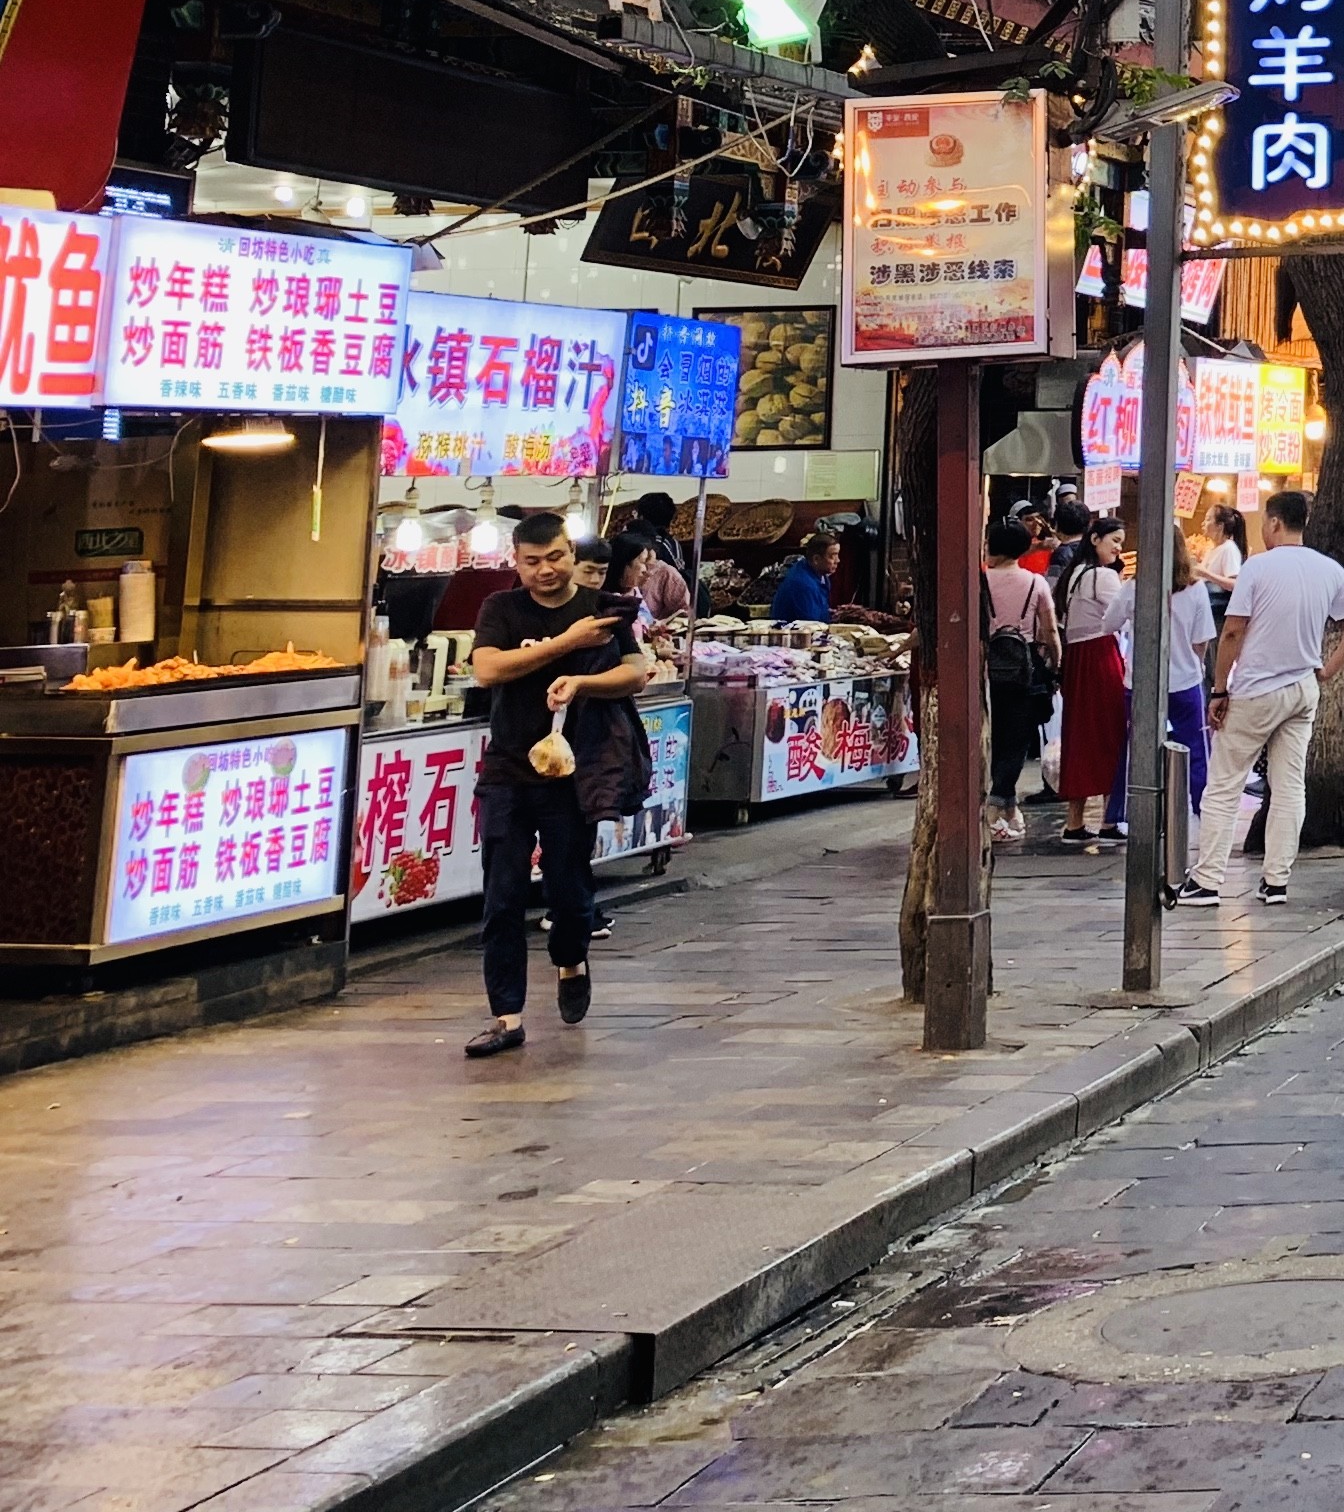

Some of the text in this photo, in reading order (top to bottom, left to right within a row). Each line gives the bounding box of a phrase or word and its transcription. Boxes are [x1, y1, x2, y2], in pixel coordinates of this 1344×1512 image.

[877, 176, 967, 198] 主动参与
[238, 236, 316, 266] 回坊特色小吃
[869, 258, 1017, 285] 涉黑涉恶线索
[126, 254, 401, 327] 炒年糕 炒琅琊土豆
[121, 315, 397, 381] 炒面筋 铁板香豆腐
[159, 379, 358, 405] 香辣味 五香味 番茄味 糖醋味
[1259, 390, 1303, 424] 烤冷面
[1258, 431, 1301, 465] 炒凉粉
[786, 713, 910, 782] 酸梅粉
[128, 765, 336, 843] 炒年糕 炒琅琊土豆
[361, 735, 489, 869] 榨石
[122, 816, 333, 902] 炒面筋 铁板香豆腐
[149, 902, 182, 927] 香辣味
[192, 895, 224, 918] 五香味
[235, 886, 266, 909] 番茄味
